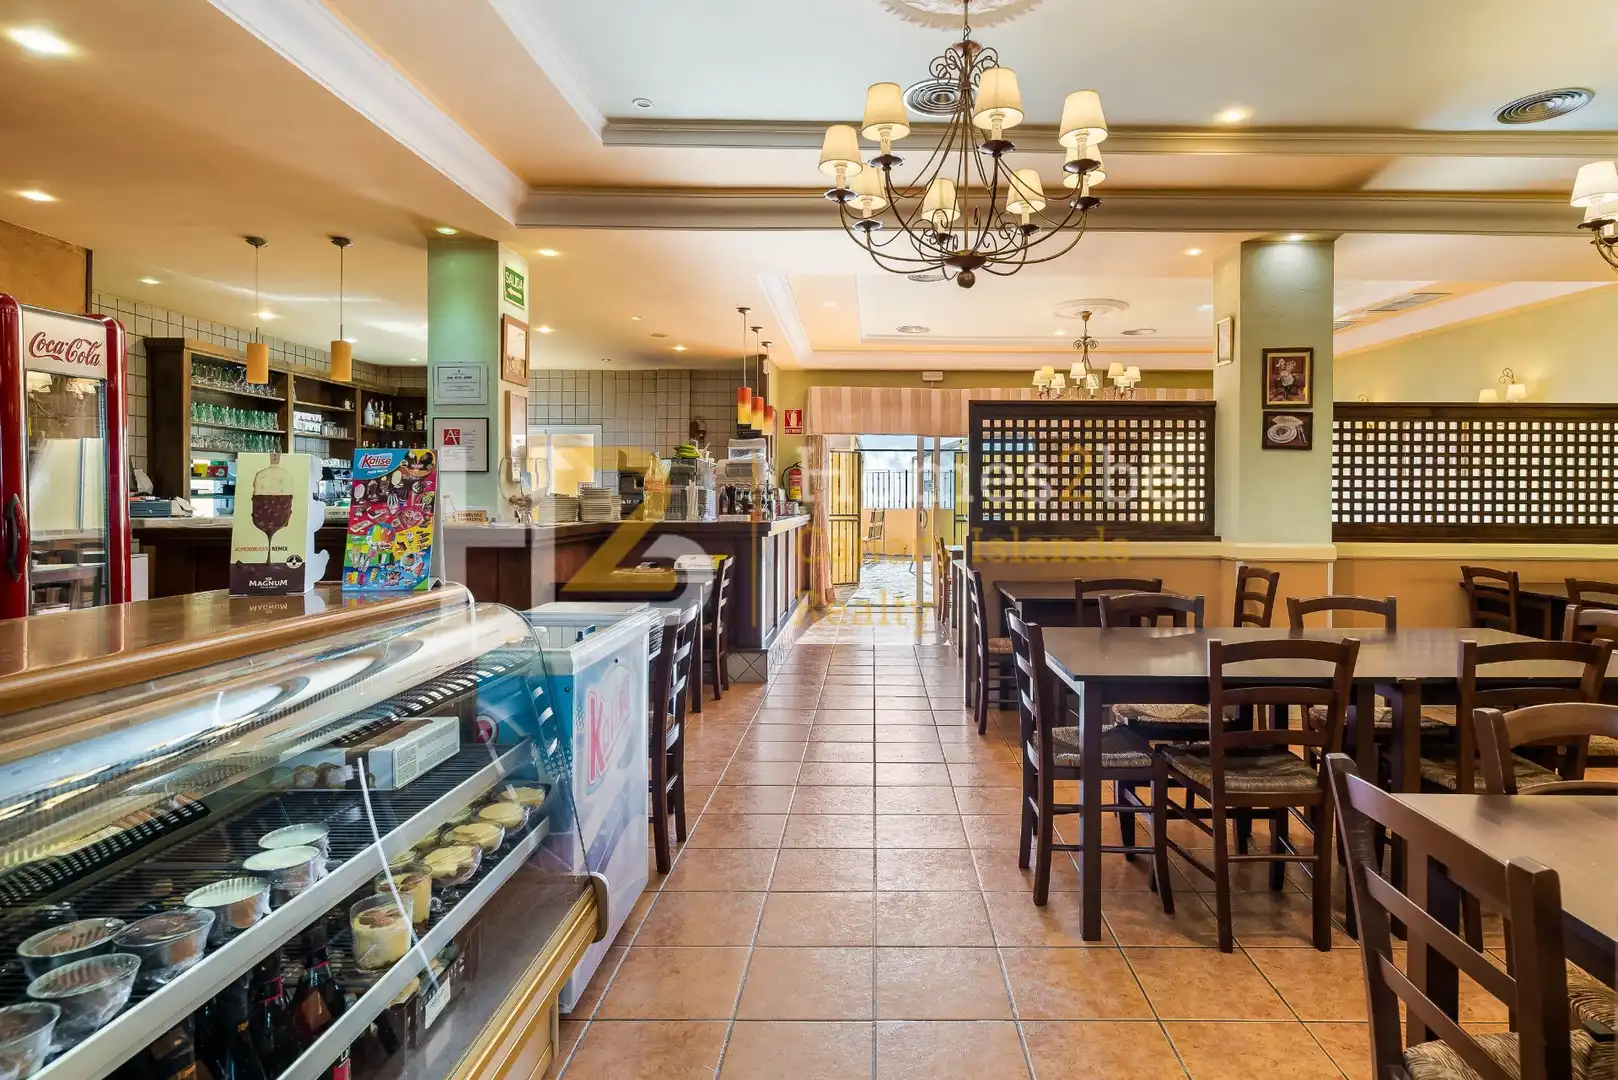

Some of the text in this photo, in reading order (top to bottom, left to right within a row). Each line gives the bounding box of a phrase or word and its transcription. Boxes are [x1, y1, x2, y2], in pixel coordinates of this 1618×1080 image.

[505, 271, 523, 290] SALIDA
[28, 331, 103, 367] Coca-Cola
[361, 453, 392, 469] Kalise
[248, 579, 288, 587] MAGNUM
